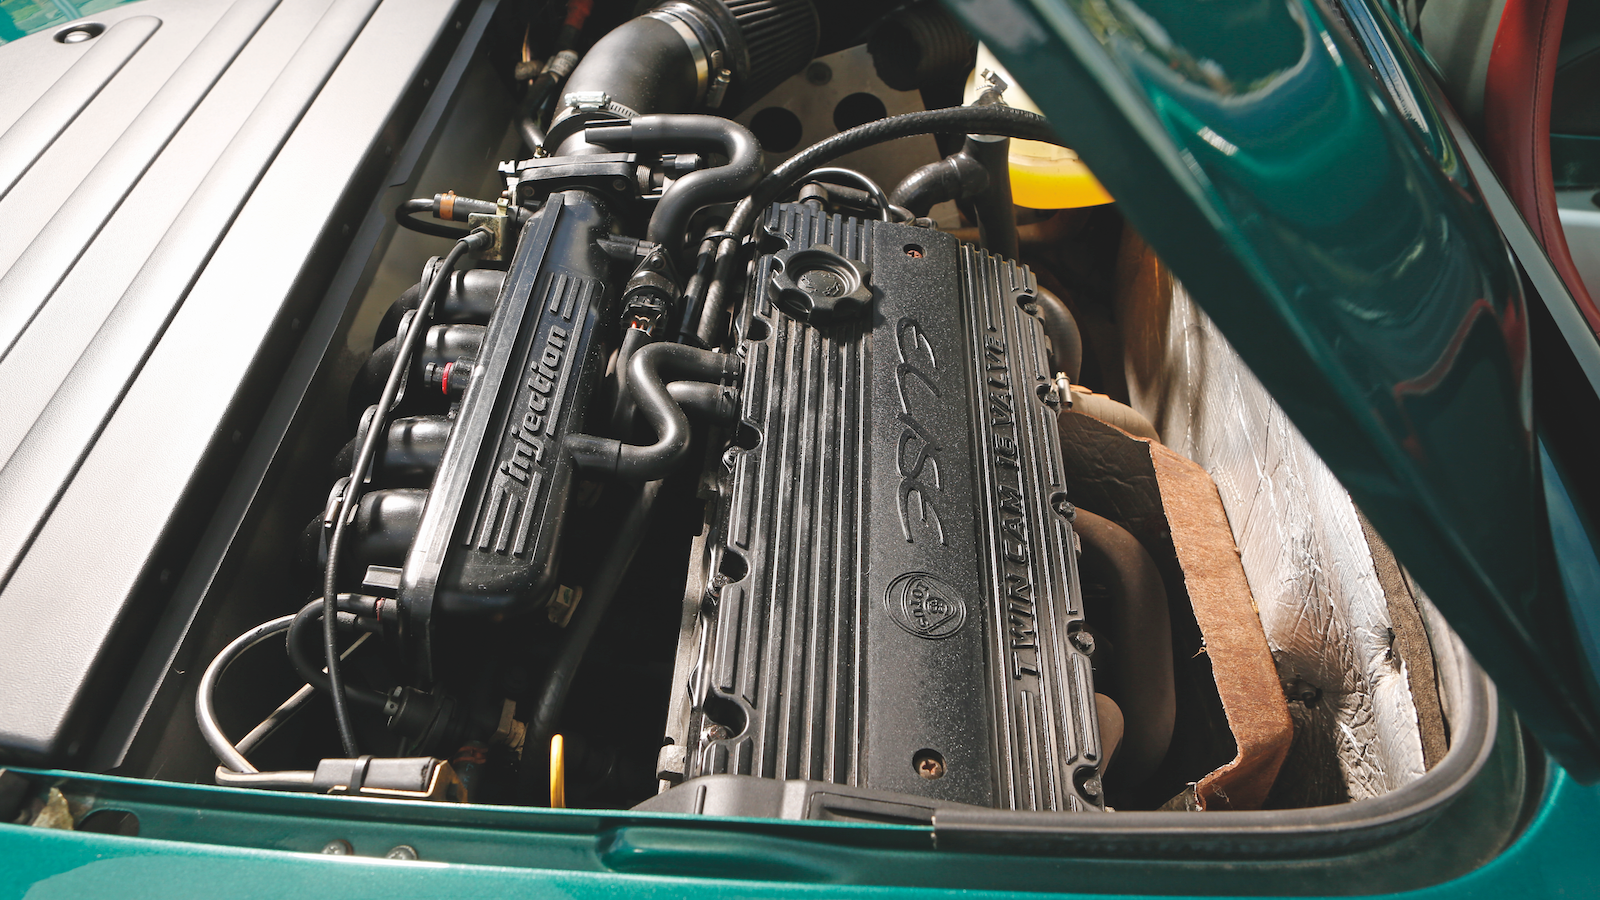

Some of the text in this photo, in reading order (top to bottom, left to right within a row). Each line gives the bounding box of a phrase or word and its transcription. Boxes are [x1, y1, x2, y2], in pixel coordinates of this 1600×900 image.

[501, 324, 570, 482] injection
[984, 334, 1040, 680] TWIN CAM 16 VALVE
[909, 581, 930, 628] LOTUS
